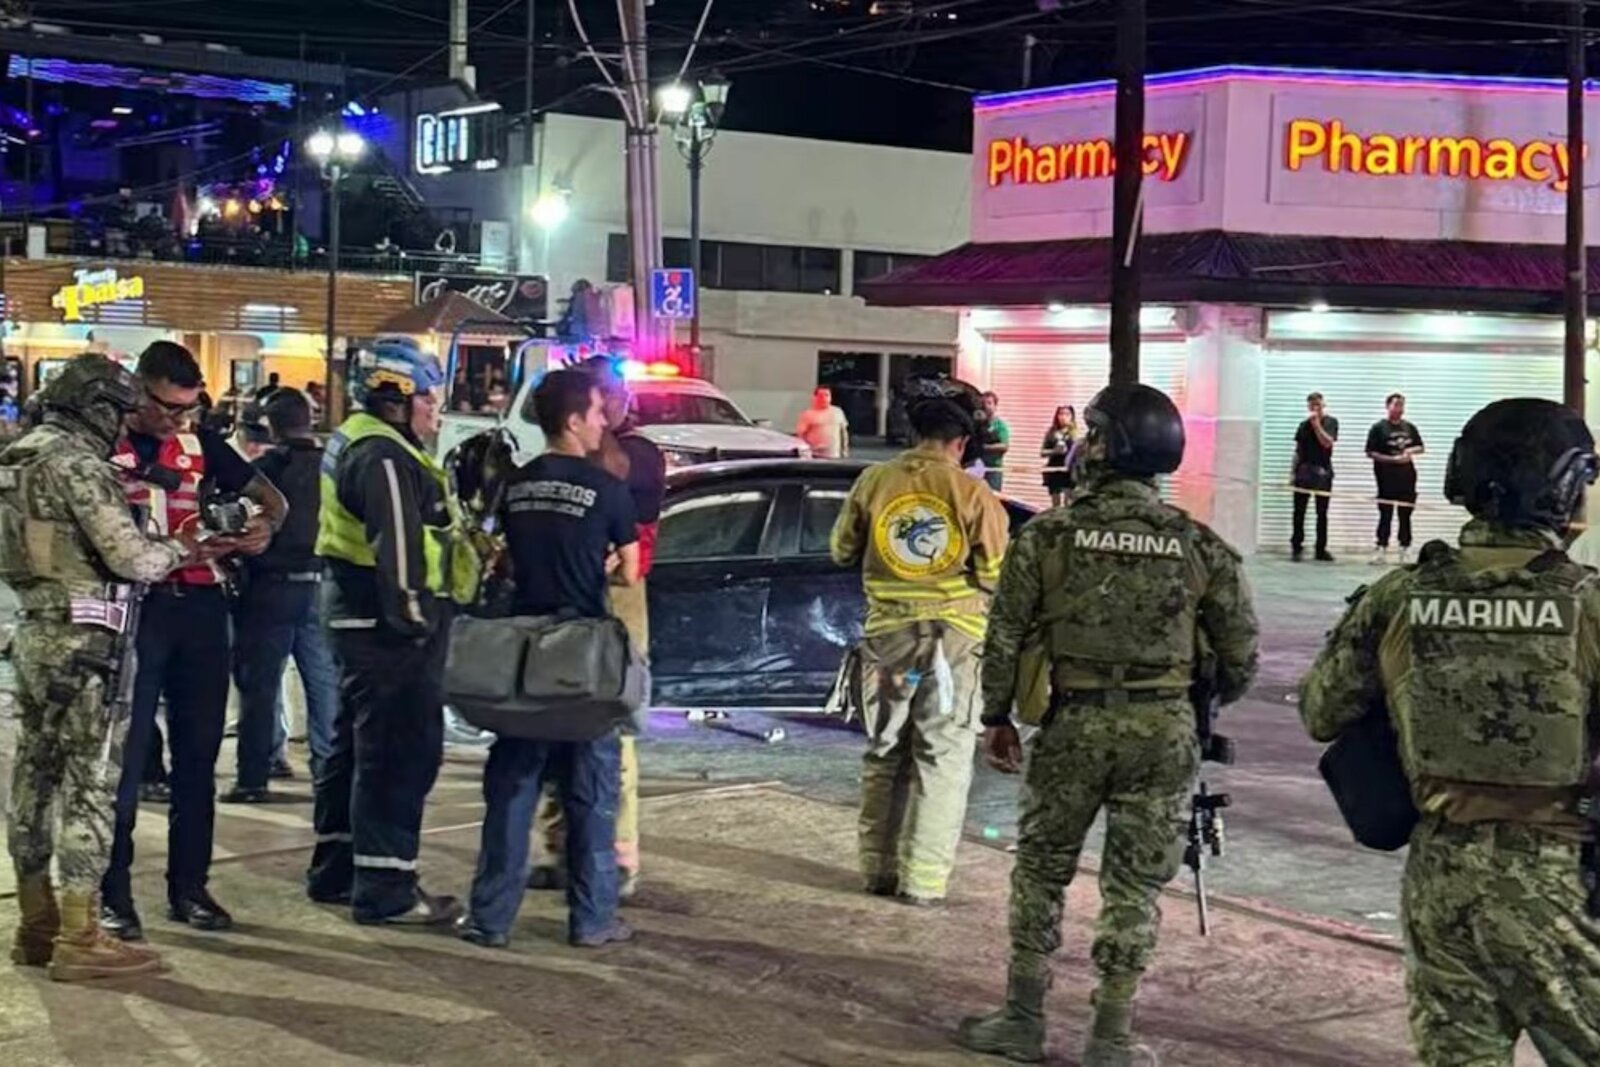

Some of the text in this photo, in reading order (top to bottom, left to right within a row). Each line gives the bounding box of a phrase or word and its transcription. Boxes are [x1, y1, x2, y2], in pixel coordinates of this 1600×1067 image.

[989, 133, 1189, 187] Pharmcy
[1074, 529, 1183, 558] MARINA
[1409, 598, 1564, 628] MARINA
